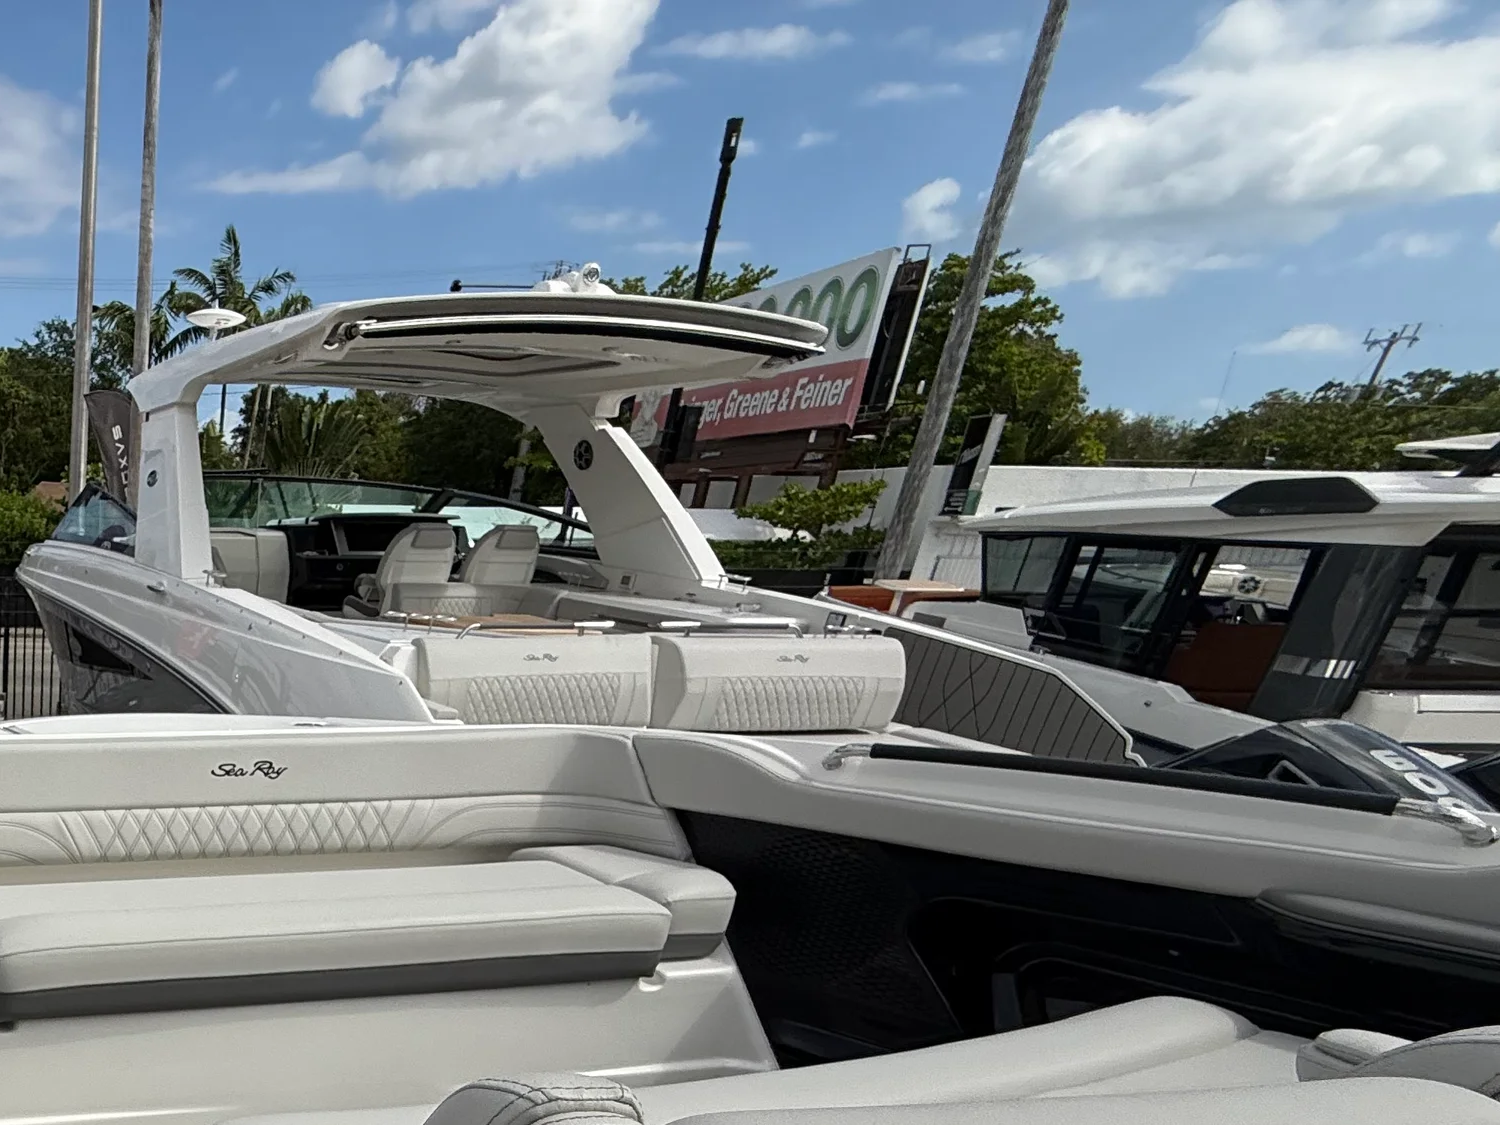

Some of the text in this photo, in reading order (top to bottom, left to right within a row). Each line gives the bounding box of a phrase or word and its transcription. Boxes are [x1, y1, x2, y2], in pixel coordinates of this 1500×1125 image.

[724, 388, 779, 420] Greene
[777, 386, 790, 413] &
[790, 374, 853, 411] Feiner
[541, 653, 558, 662] Ray
[793, 654, 809, 663] Ray
[211, 760, 288, 779] Sea Ray
